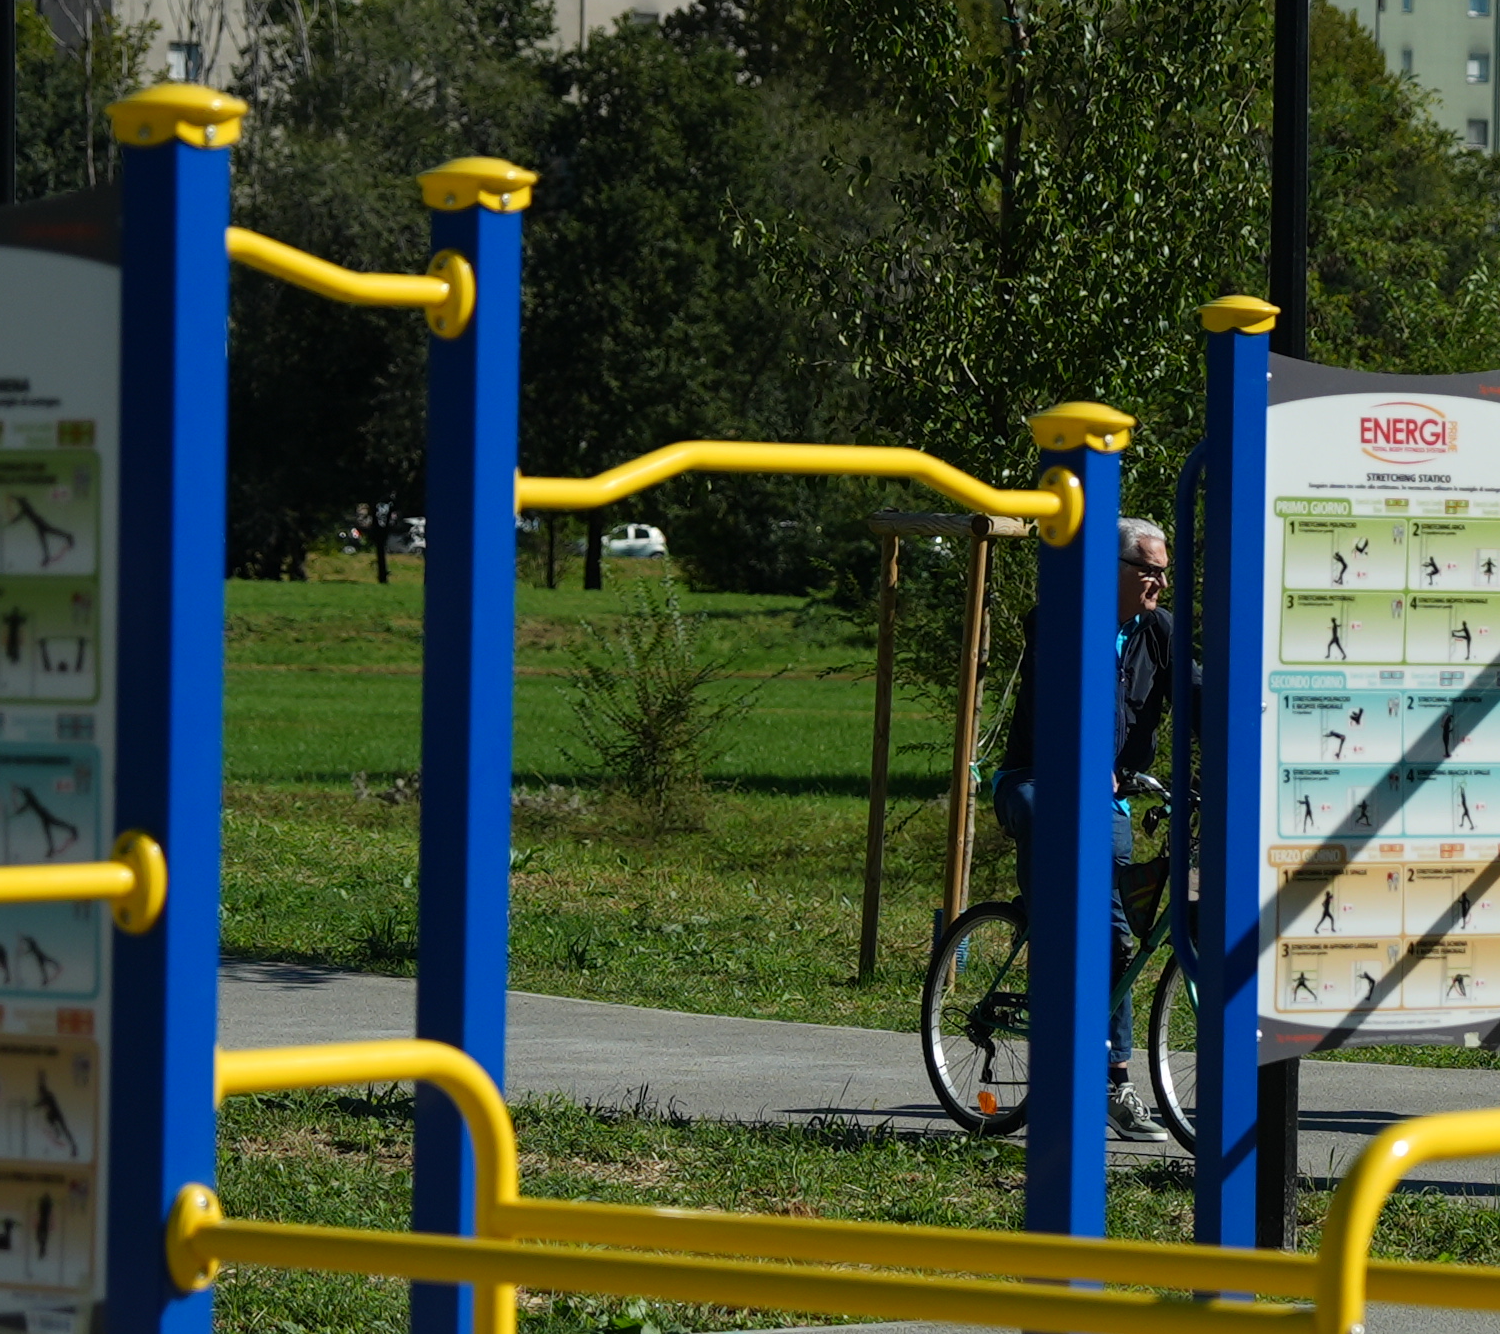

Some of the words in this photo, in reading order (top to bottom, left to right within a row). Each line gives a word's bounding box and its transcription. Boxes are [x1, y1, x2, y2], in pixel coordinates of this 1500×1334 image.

[1360, 417, 1448, 446] ENERGI
[1448, 420, 1459, 453] PRIME
[1366, 472, 1417, 483] STRETCHING
[1418, 473, 1452, 484] STATICO
[1276, 500, 1309, 514] PRIMO
[1310, 501, 1350, 515] GIORNO
[1289, 520, 1295, 535] 1
[1412, 522, 1420, 537] 2
[1286, 594, 1294, 609] 3
[1410, 596, 1417, 610] 4
[1271, 674, 1310, 689] SECONDO
[1311, 675, 1344, 690] GIORNO
[1284, 694, 1289, 709] 1
[1407, 696, 1414, 710] 2
[1283, 768, 1290, 783] 3
[1406, 768, 1415, 783] 4
[1271, 848, 1301, 863] TERZO
[1302, 849, 1341, 864] GIORNO
[1283, 868, 1289, 884] 1
[1407, 867, 1415, 882] 2
[1281, 942, 1289, 958] 3
[1407, 940, 1414, 956] 4
